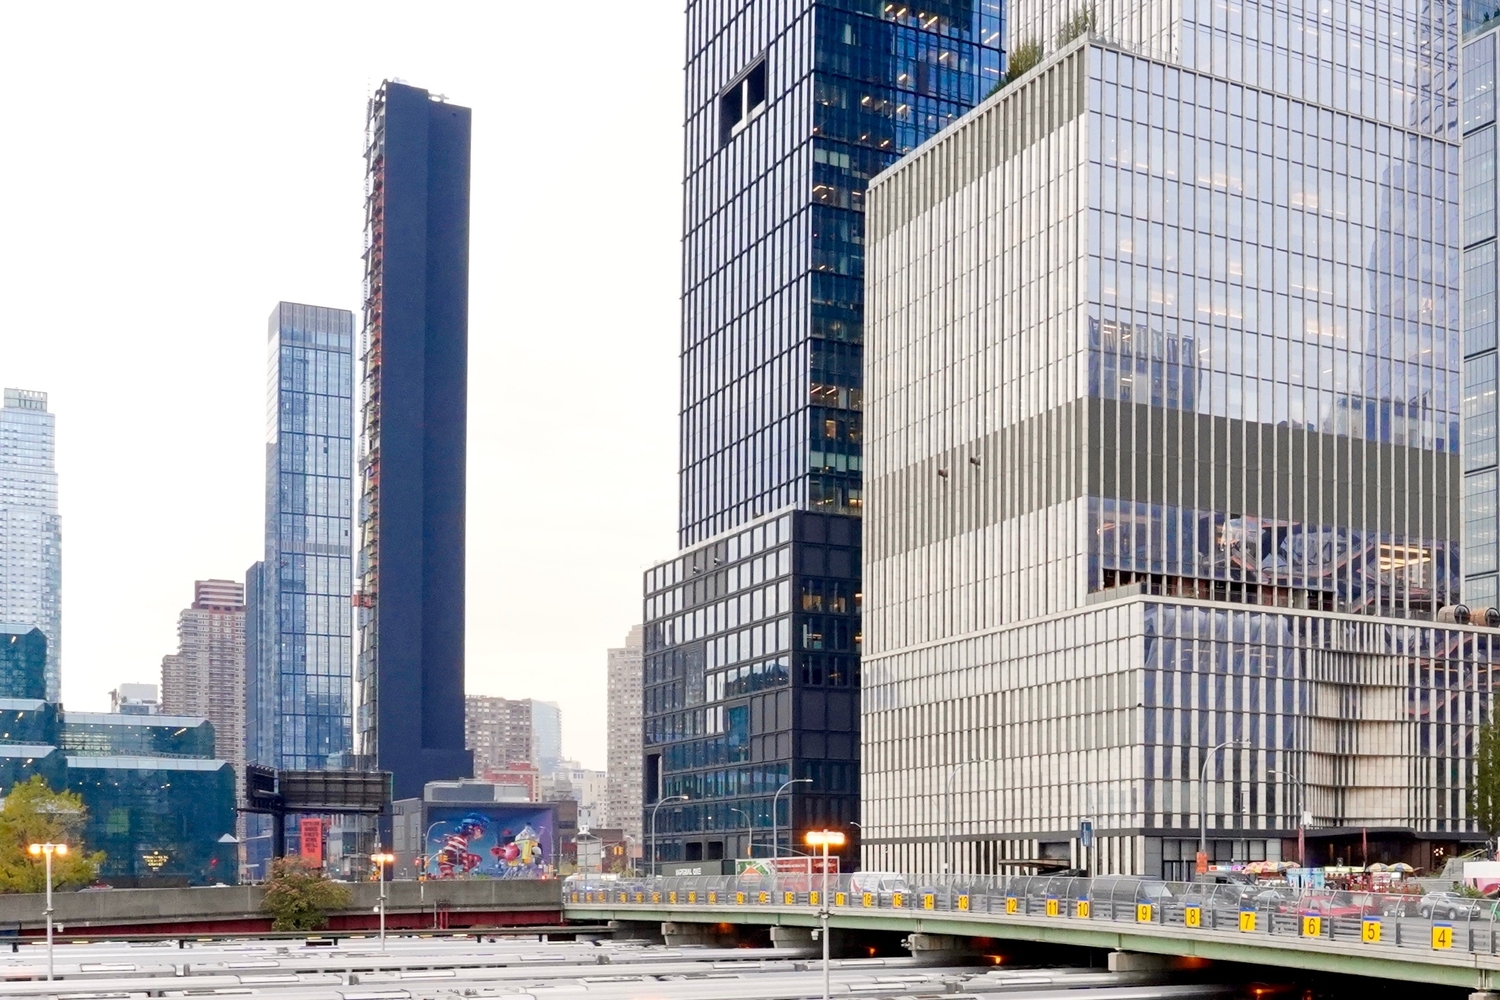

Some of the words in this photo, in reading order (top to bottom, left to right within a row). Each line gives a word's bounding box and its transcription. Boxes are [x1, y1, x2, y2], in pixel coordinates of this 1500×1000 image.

[894, 895, 901, 907] 15
[925, 895, 933, 909] 14
[959, 896, 968, 909] 13
[1007, 898, 1016, 912] 12
[1048, 901, 1056, 915] 11
[1078, 903, 1088, 916] 10
[1142, 906, 1147, 920] 9
[1190, 909, 1196, 924] 8
[1244, 914, 1250, 929] 7
[1308, 918, 1315, 934] 6
[1368, 923, 1375, 939] 5
[1437, 930, 1445, 946] 4
